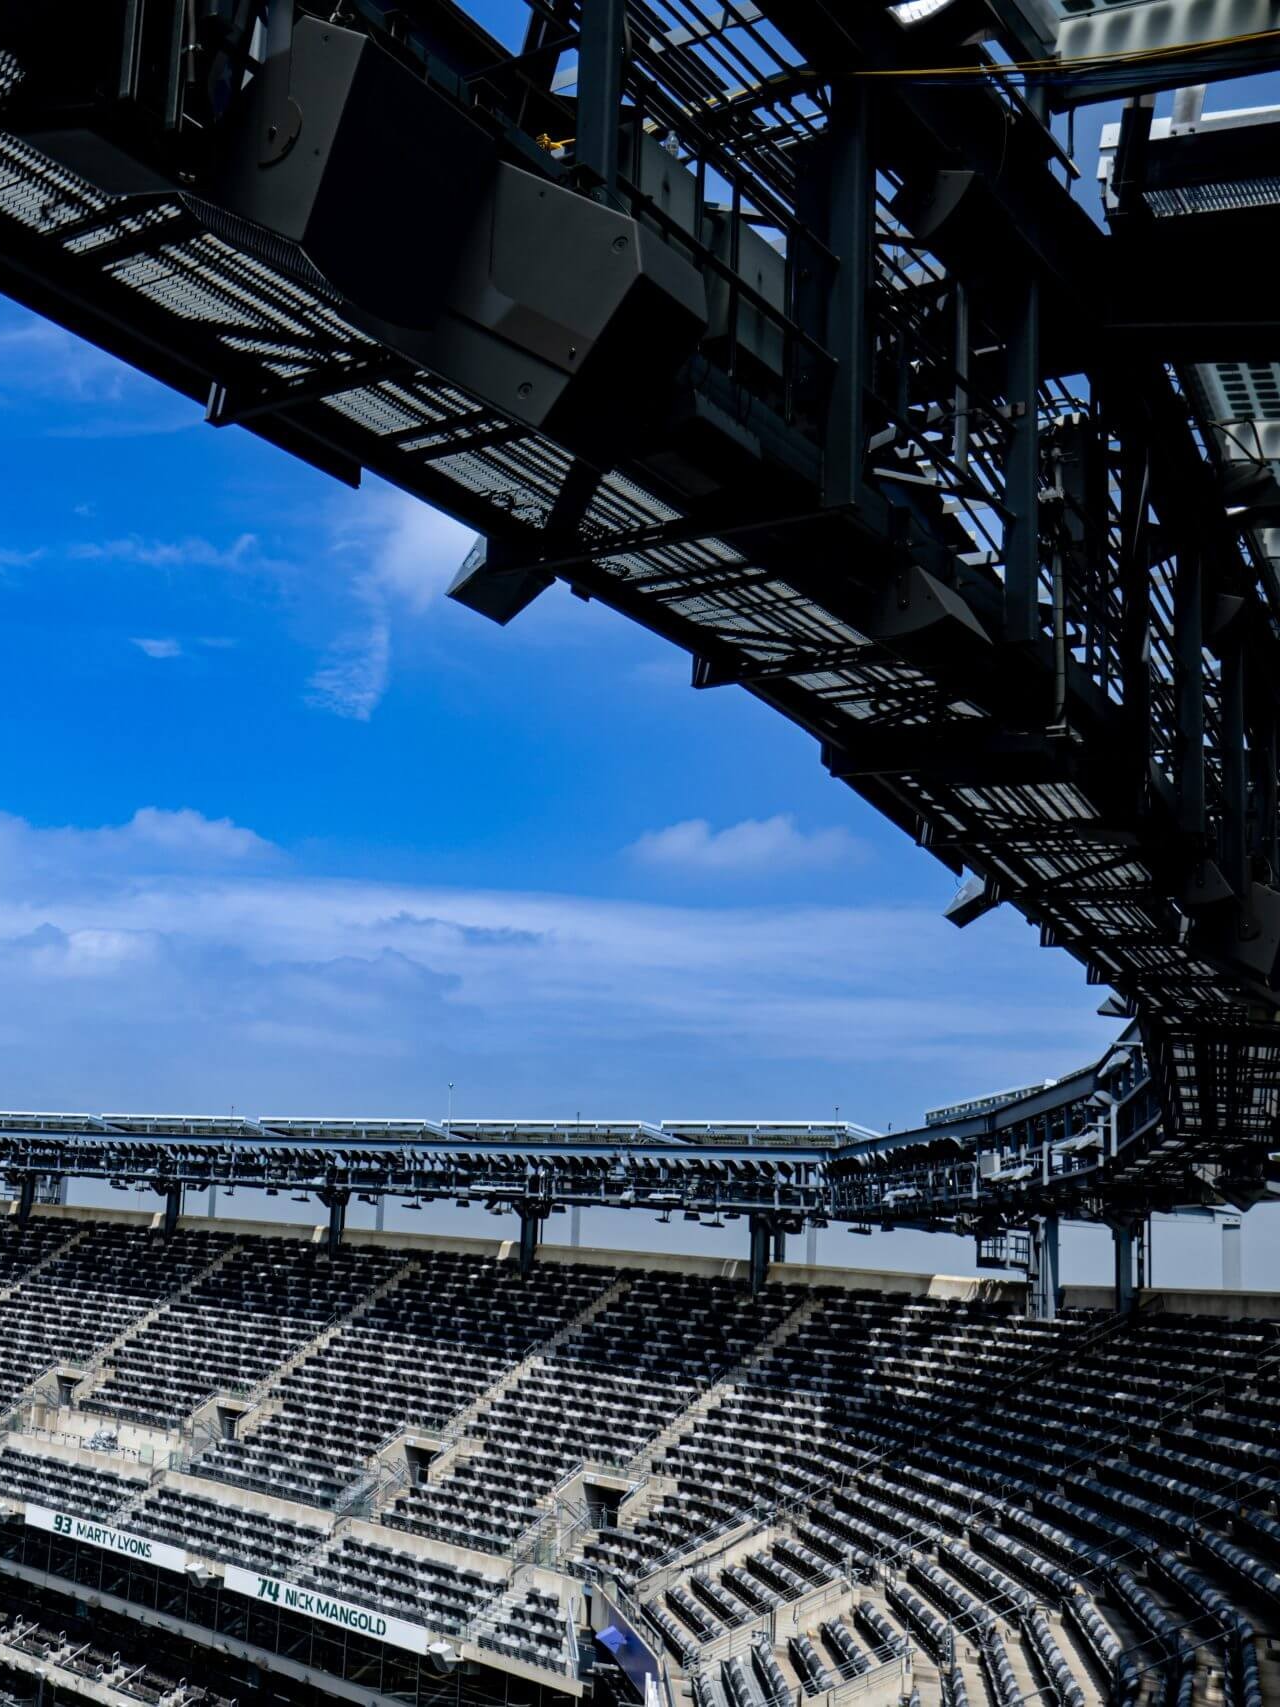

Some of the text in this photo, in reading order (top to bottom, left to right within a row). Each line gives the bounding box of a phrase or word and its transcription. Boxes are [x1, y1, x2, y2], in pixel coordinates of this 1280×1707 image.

[53, 1514, 153, 1559] 93 MARTY LYONS
[256, 1577, 388, 1637] 74 NICK MANGOLD
